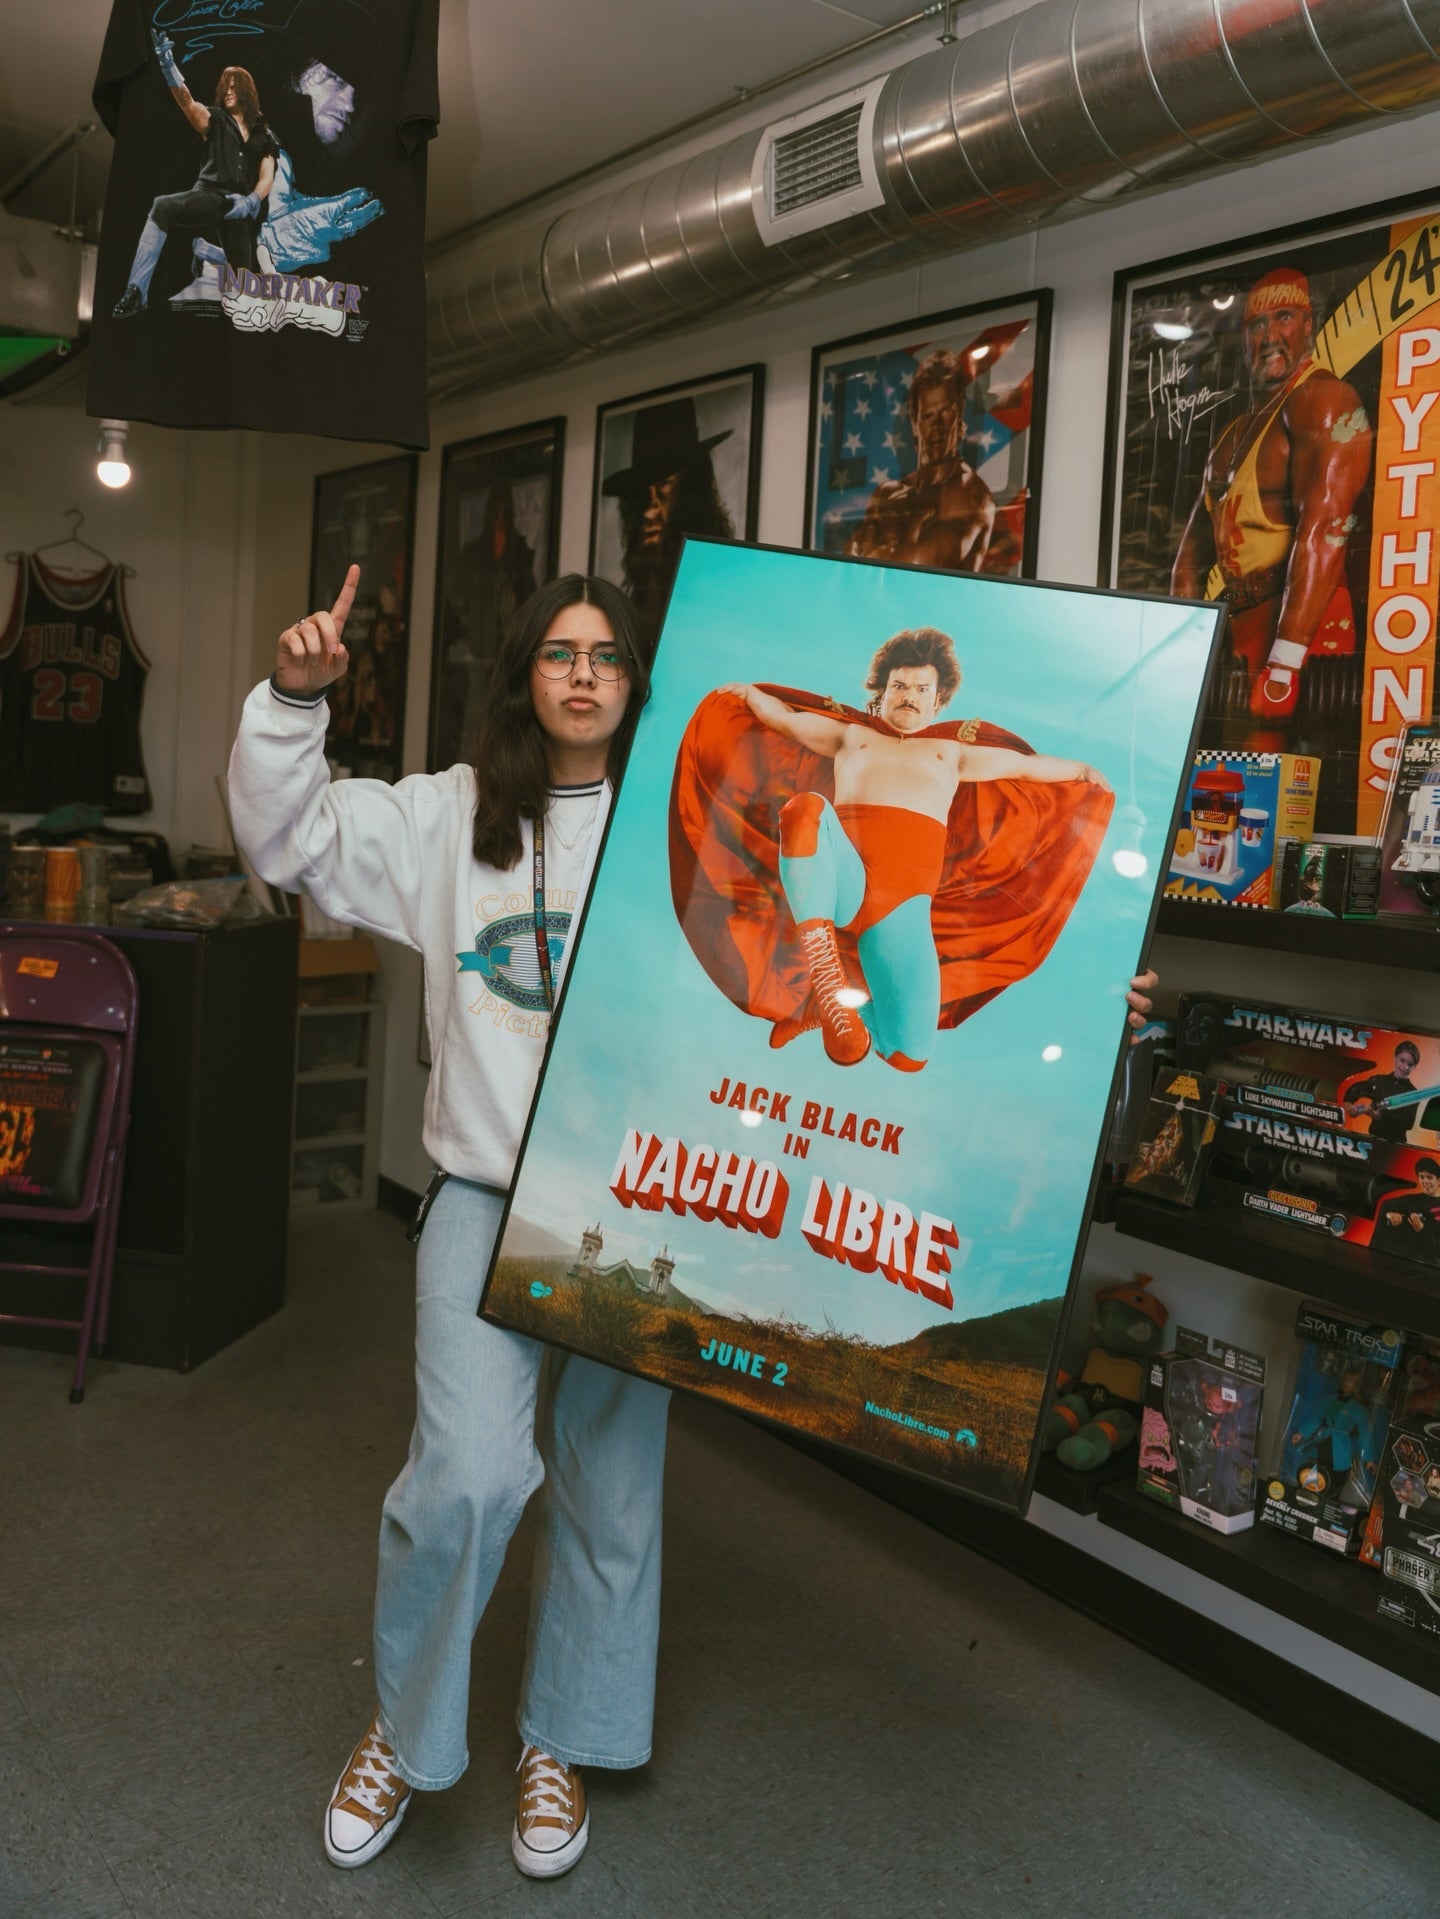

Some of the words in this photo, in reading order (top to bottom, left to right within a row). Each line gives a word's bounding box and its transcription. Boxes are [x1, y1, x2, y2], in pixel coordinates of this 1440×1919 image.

[20, 622, 123, 681] BULLS
[32, 668, 104, 724] 23
[1223, 1009, 1296, 1038] STAR
[1294, 1019, 1373, 1051] WARS
[709, 1077, 792, 1123] JACK
[801, 1100, 905, 1156] BLACK
[1244, 1090, 1260, 1103] LUKE
[1300, 1103, 1339, 1121] LIGHTSABER
[783, 1132, 811, 1159] IN
[1223, 1111, 1296, 1143] STAR
[1294, 1126, 1373, 1160] WARS
[608, 1127, 790, 1239] NACHO
[800, 1174, 960, 1311] LIBRE
[1248, 1196, 1269, 1209] DARTH
[1269, 1201, 1289, 1215] VADER
[1291, 1208, 1328, 1226] LIGHTSABER
[1269, 1190, 1315, 1211] ELECTRONIC
[1298, 1316, 1338, 1337] STAR
[1344, 1328, 1392, 1354] TREK
[700, 1338, 767, 1380] JUNE
[771, 1361, 789, 1387] 2
[864, 1400, 950, 1441] NachoLibre.com
[1392, 1555, 1430, 1581] PHASER
